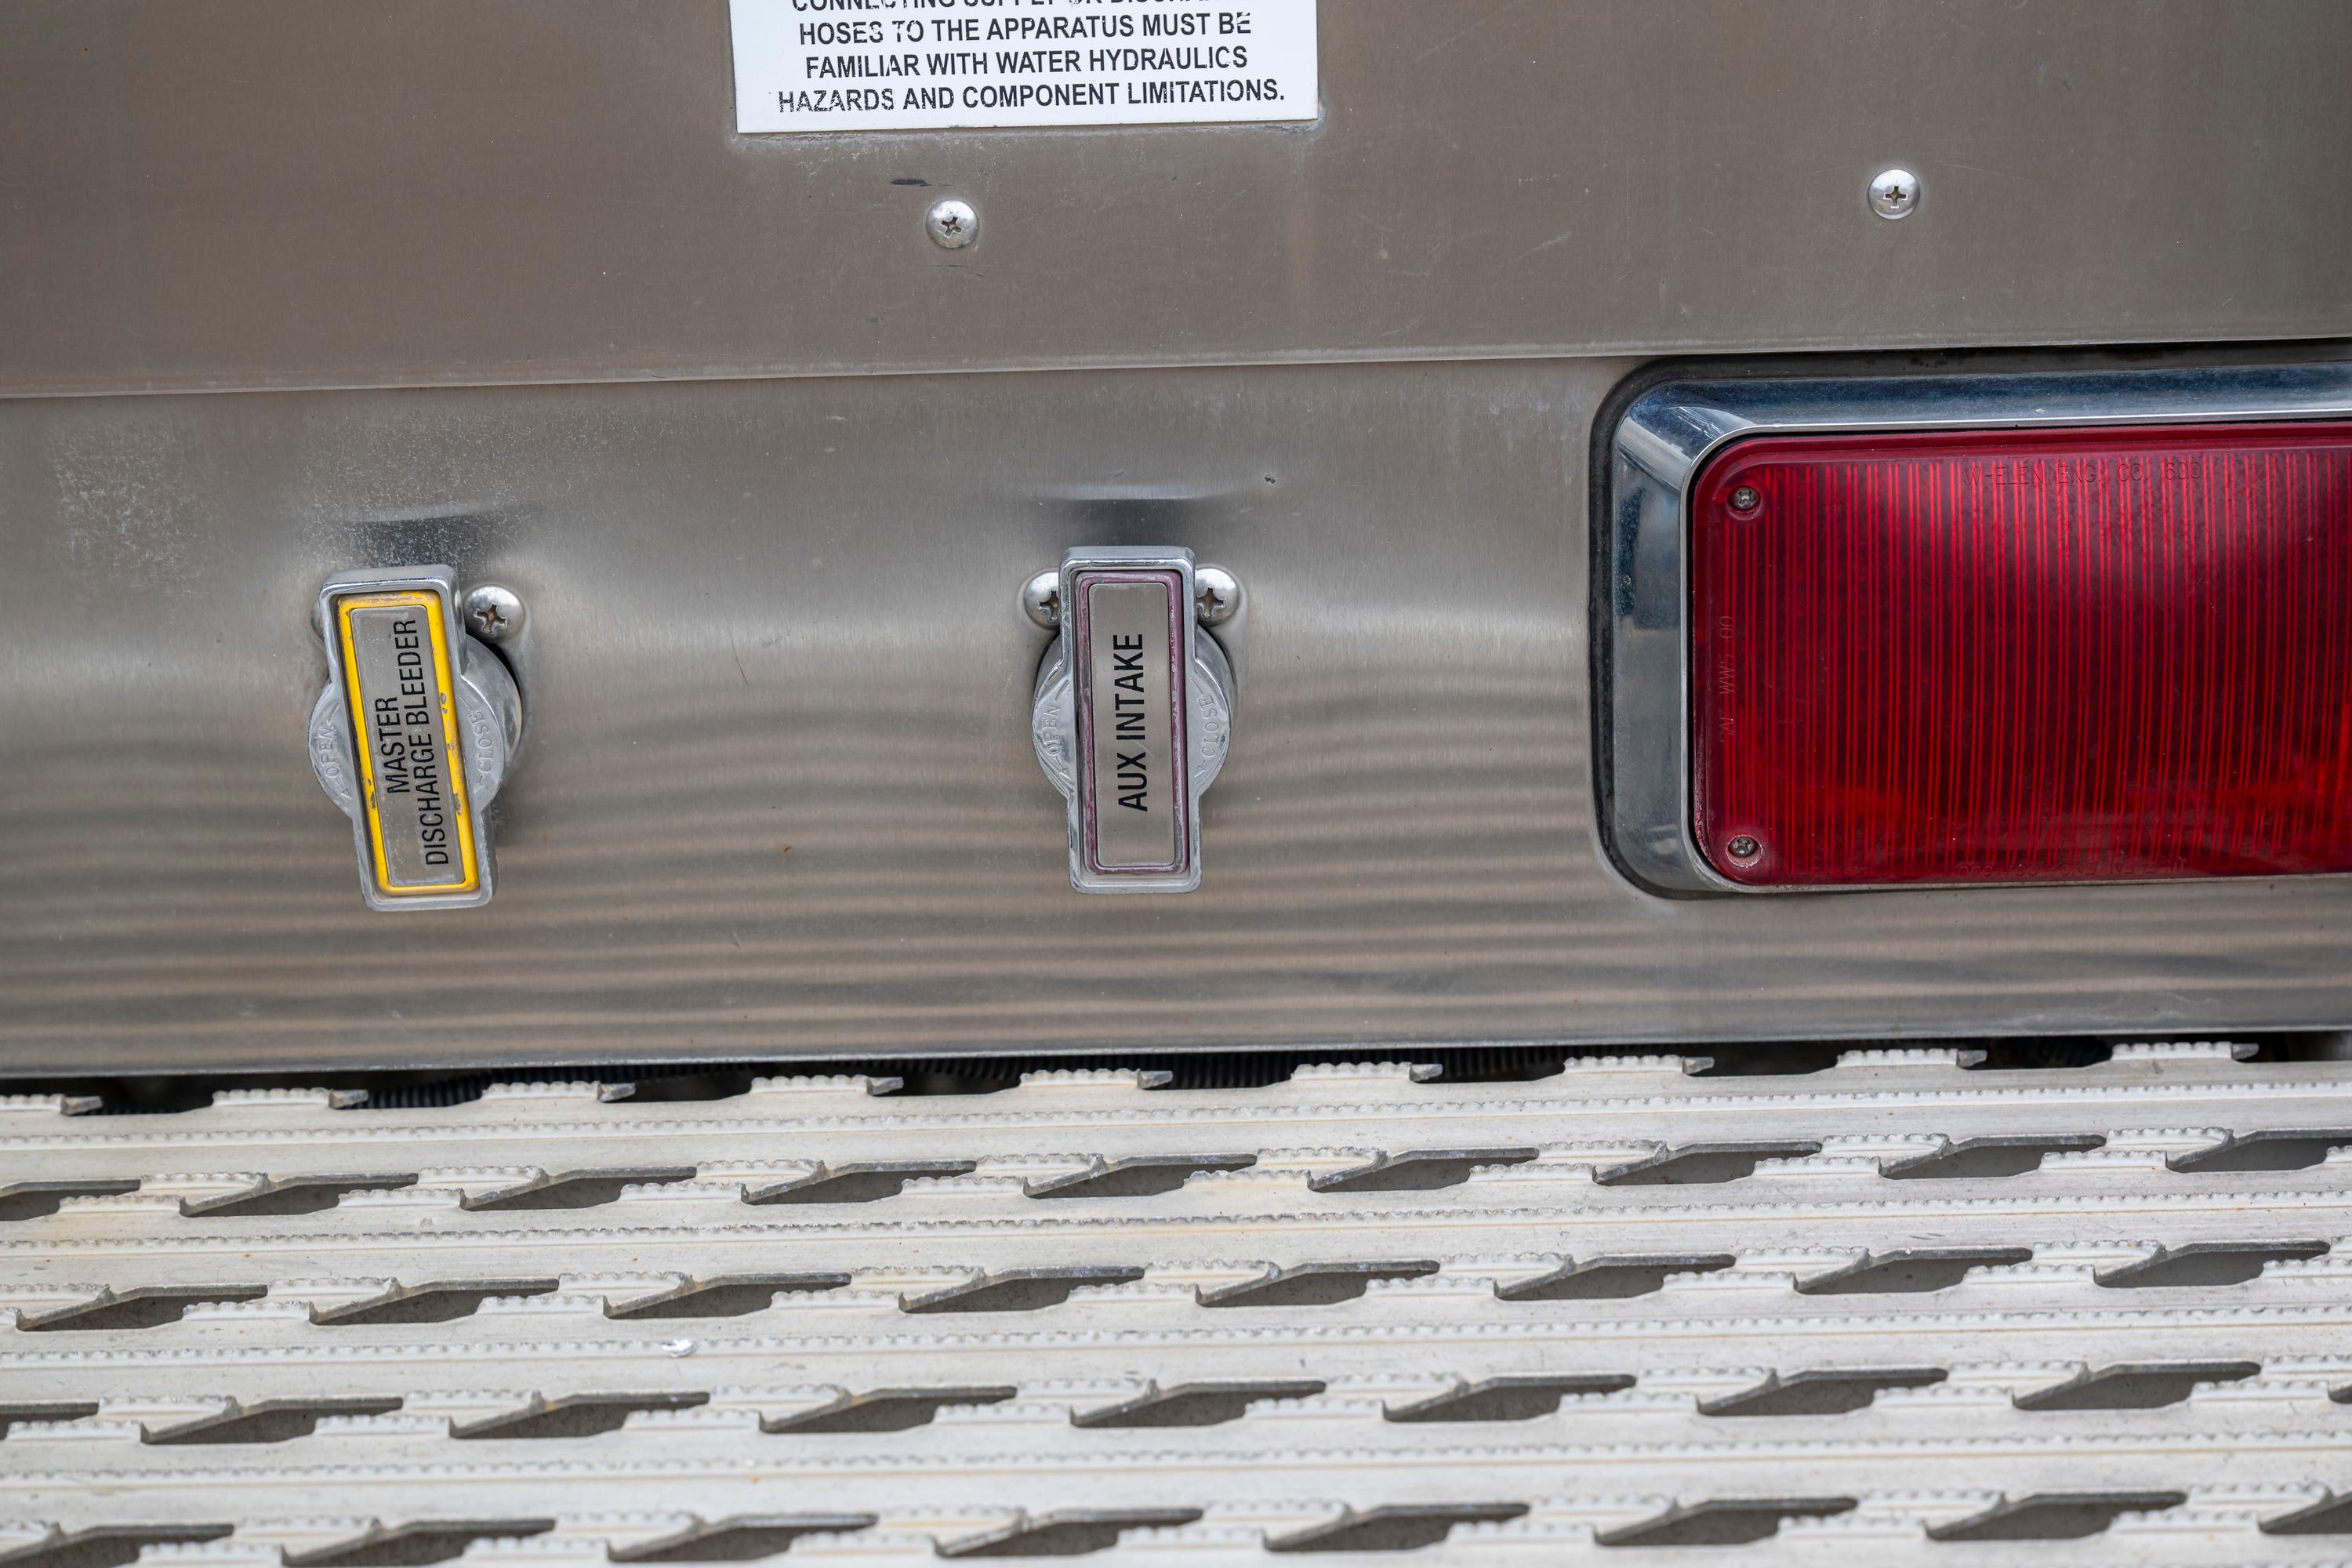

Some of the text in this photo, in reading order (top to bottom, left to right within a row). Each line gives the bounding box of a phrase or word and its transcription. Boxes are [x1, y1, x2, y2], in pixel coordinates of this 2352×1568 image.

[800, 12, 1251, 45] HOSES TO THE APPARATUS MUST BE
[806, 45, 1247, 78] FAMILIAR WITH WATER HYDRAULICS
[779, 78, 1285, 113] HAZARDS AND COMPONENT LIMITATIONS.
[318, 725, 340, 779] OPEN
[375, 697, 411, 793] MASTER
[394, 619, 448, 865] DISCHARGE BLEEDER
[469, 710, 494, 774] CLOSE
[1113, 634, 1148, 811] AUX INTAKE
[1196, 695, 1218, 759] CLOSE
